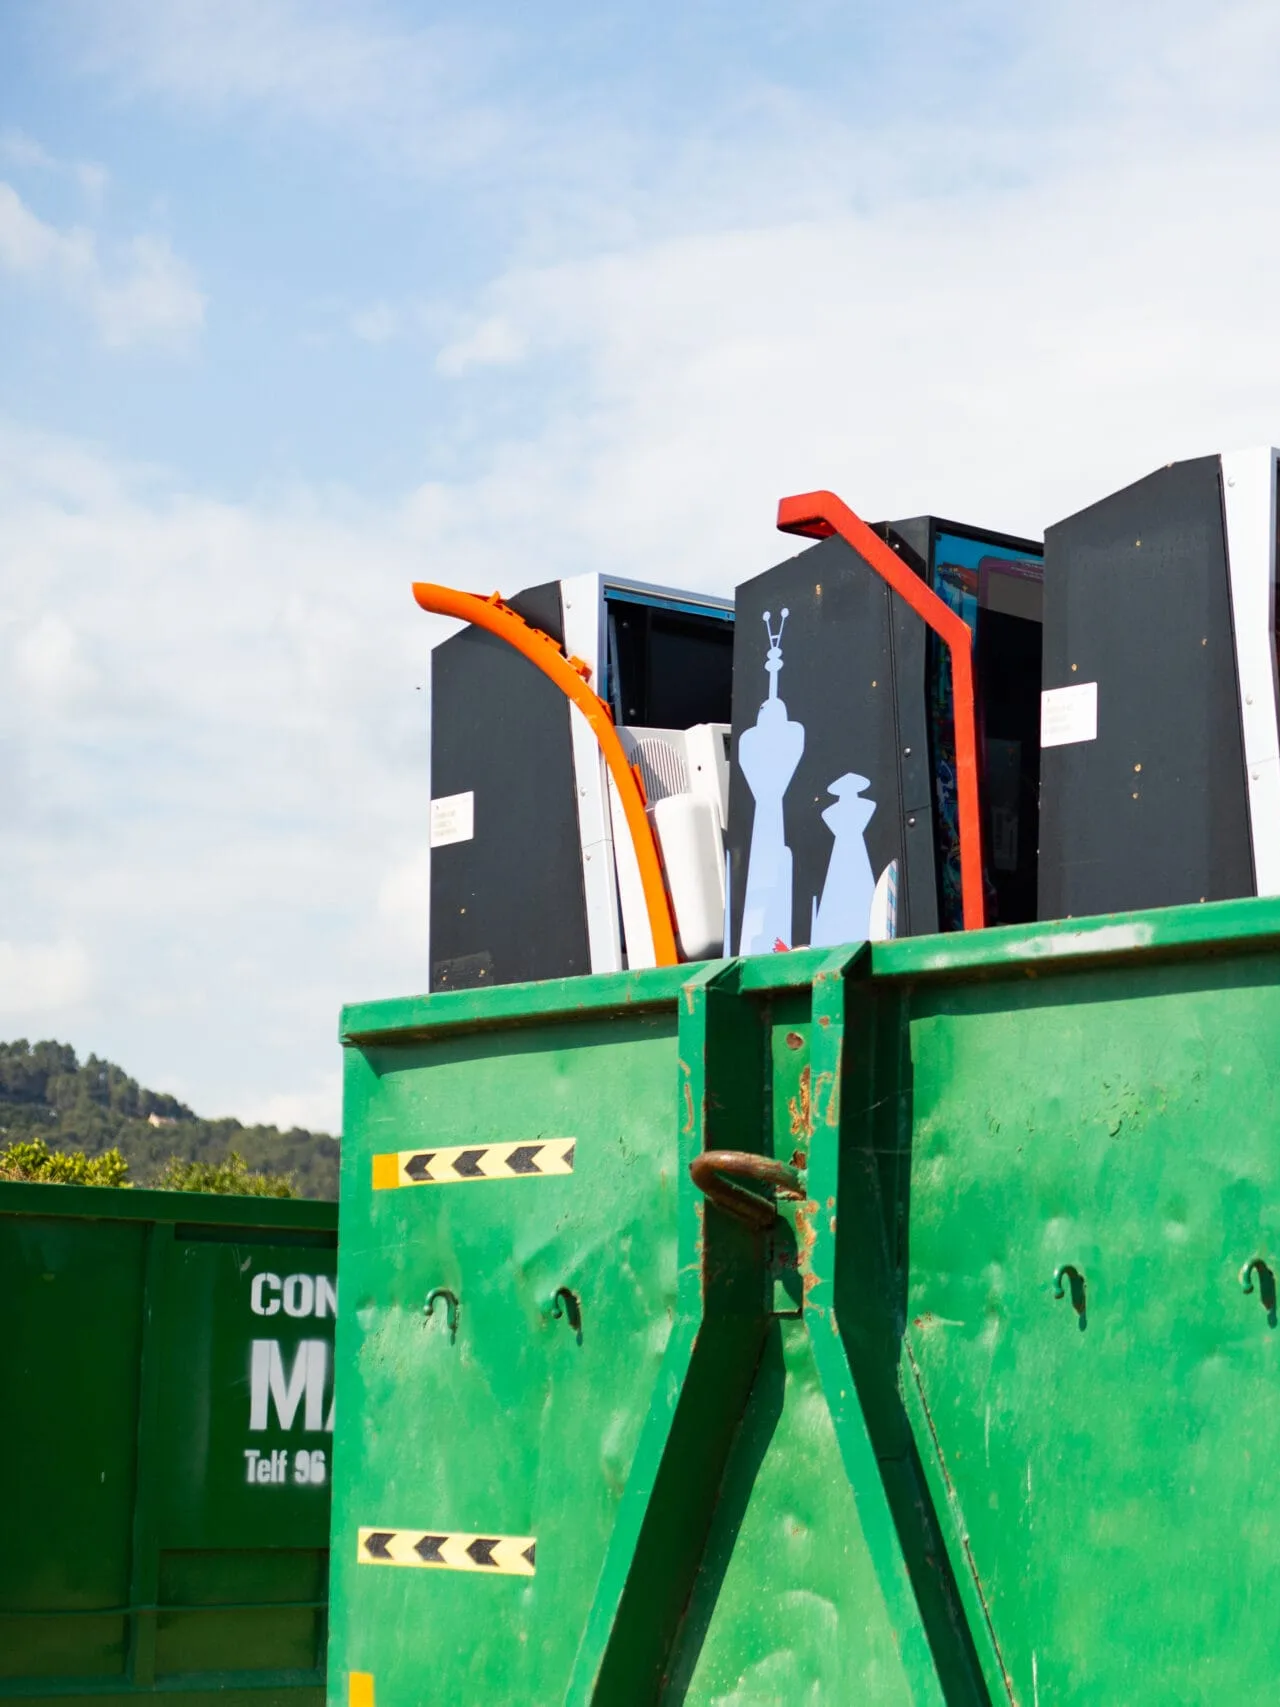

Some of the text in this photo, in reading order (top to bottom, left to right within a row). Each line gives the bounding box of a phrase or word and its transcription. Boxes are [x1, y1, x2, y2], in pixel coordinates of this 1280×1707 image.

[251, 1272, 338, 1318] CON
[249, 1339, 335, 1431] M
[244, 1450, 326, 1484] Telf 96
